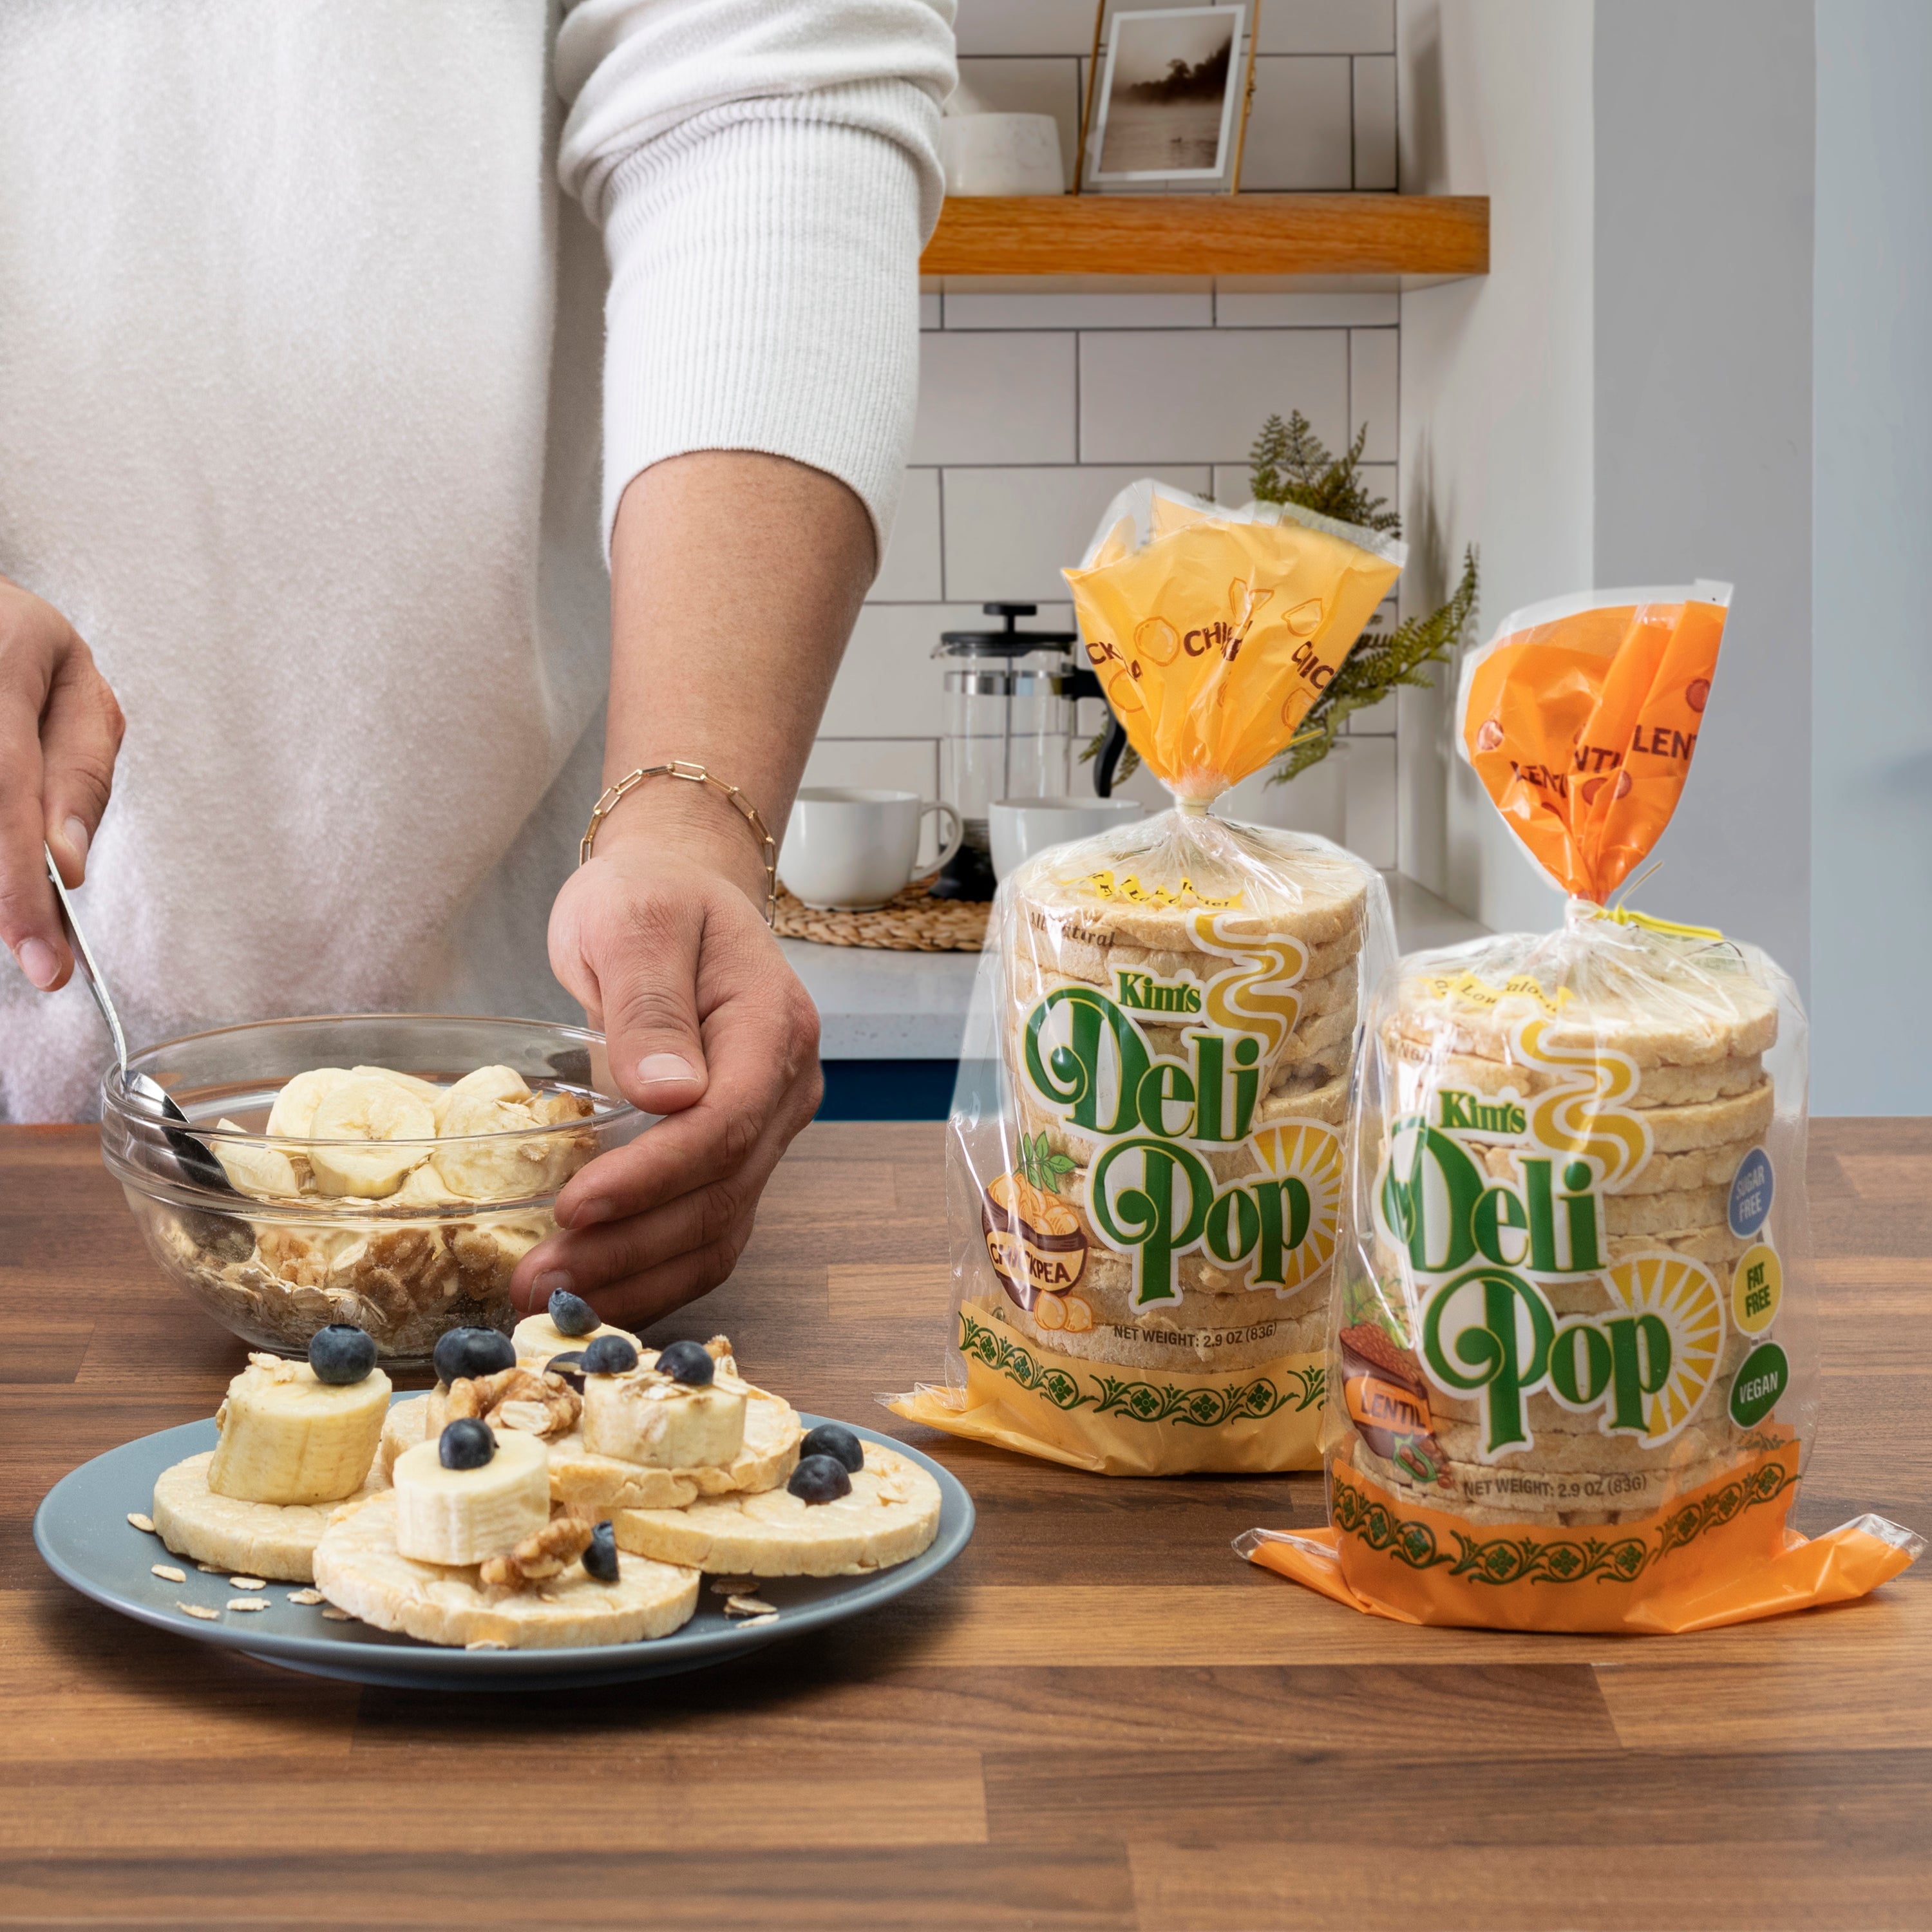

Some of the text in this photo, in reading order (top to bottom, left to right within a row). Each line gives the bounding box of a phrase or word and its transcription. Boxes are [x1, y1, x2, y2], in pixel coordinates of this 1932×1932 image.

[1115, 970, 1202, 1014] Kim's
[1023, 985, 1260, 1142] Deli
[1437, 1090, 1528, 1135] Kim's
[1381, 1116, 1607, 1273] Deli
[1736, 1164, 1765, 1200] SUGAR
[1091, 1137, 1311, 1306] Pop
[1739, 1191, 1763, 1223] FREE
[1747, 1262, 1765, 1291] FAT
[1745, 1284, 1770, 1318] FREE
[1113, 1322, 1277, 1348] NET WEIGHT: 2.9 OZ (83G)
[1421, 1268, 1672, 1455] Pop
[1739, 1370, 1778, 1404] VEGAN
[1361, 1393, 1426, 1428] LENTIL
[1464, 1474, 1647, 1498] NET WEIGHT: 2.9 OZ (83G)
